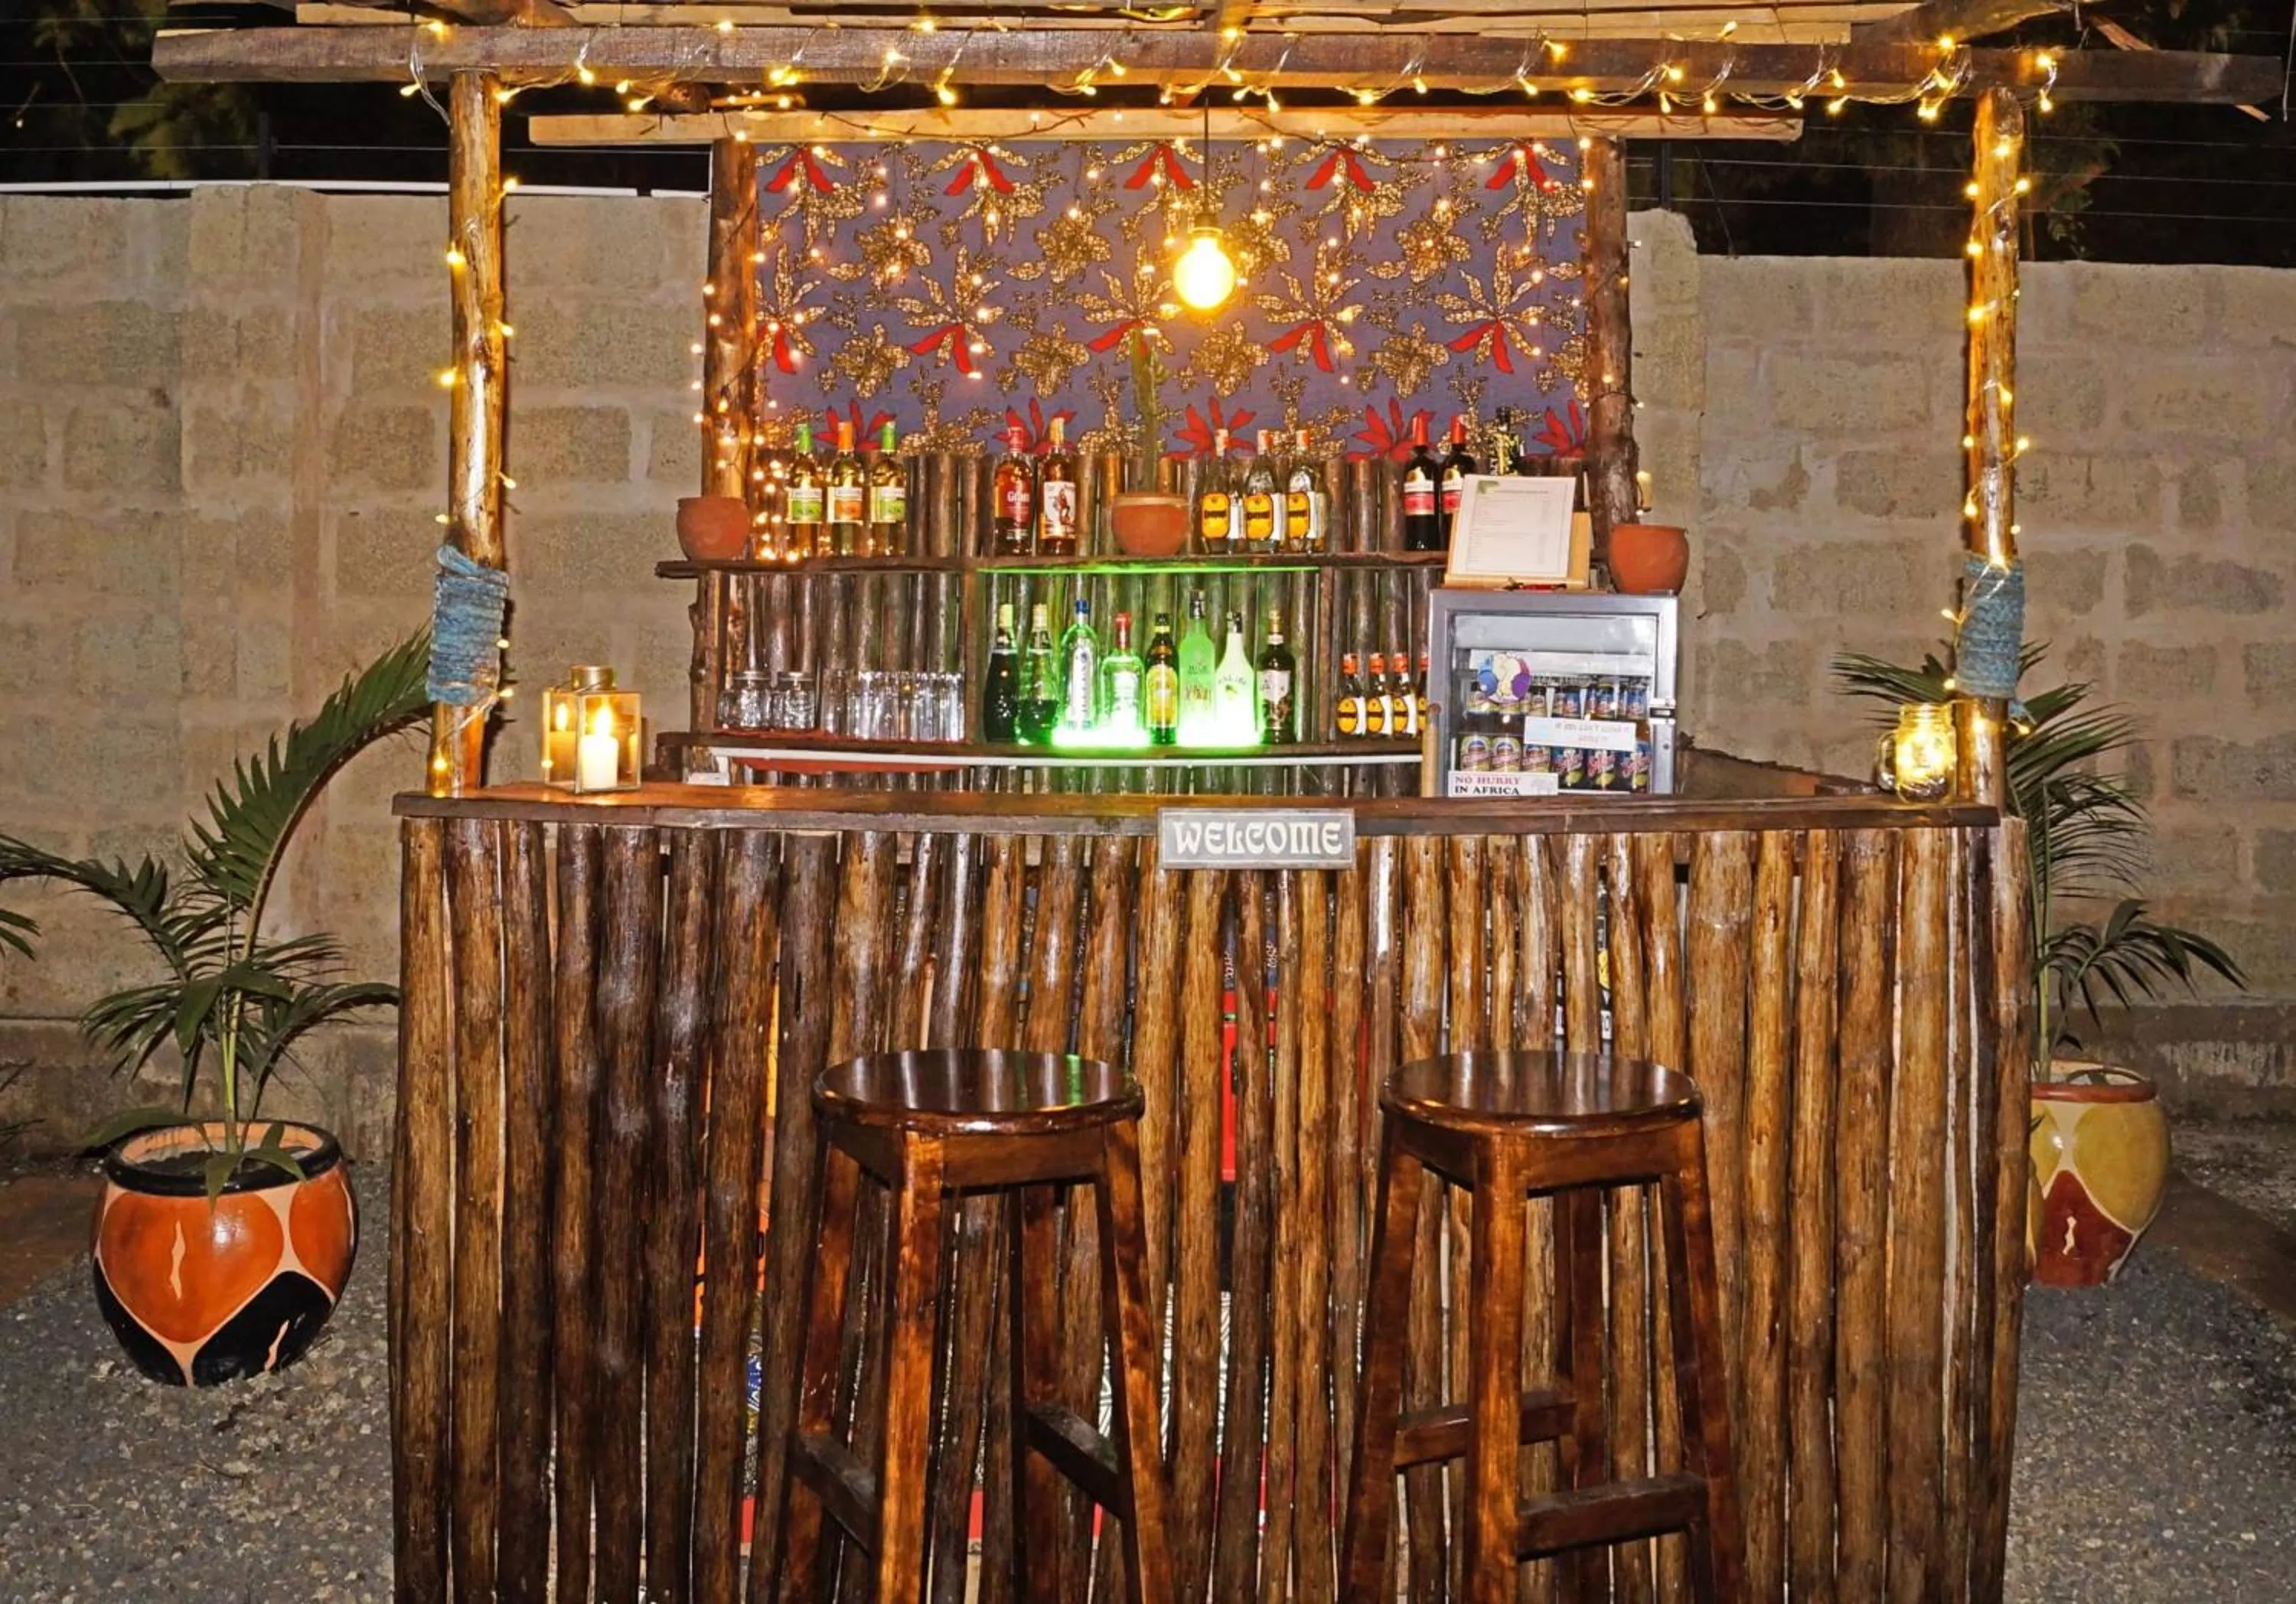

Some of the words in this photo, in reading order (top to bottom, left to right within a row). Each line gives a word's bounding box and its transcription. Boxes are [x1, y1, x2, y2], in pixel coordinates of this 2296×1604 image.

[1455, 775, 1473, 784] NO
[1477, 776, 1520, 784] HURRY
[1455, 785, 1468, 794] IN
[1473, 786, 1519, 795] AFRICA
[1172, 821, 1343, 856] WELCOME
